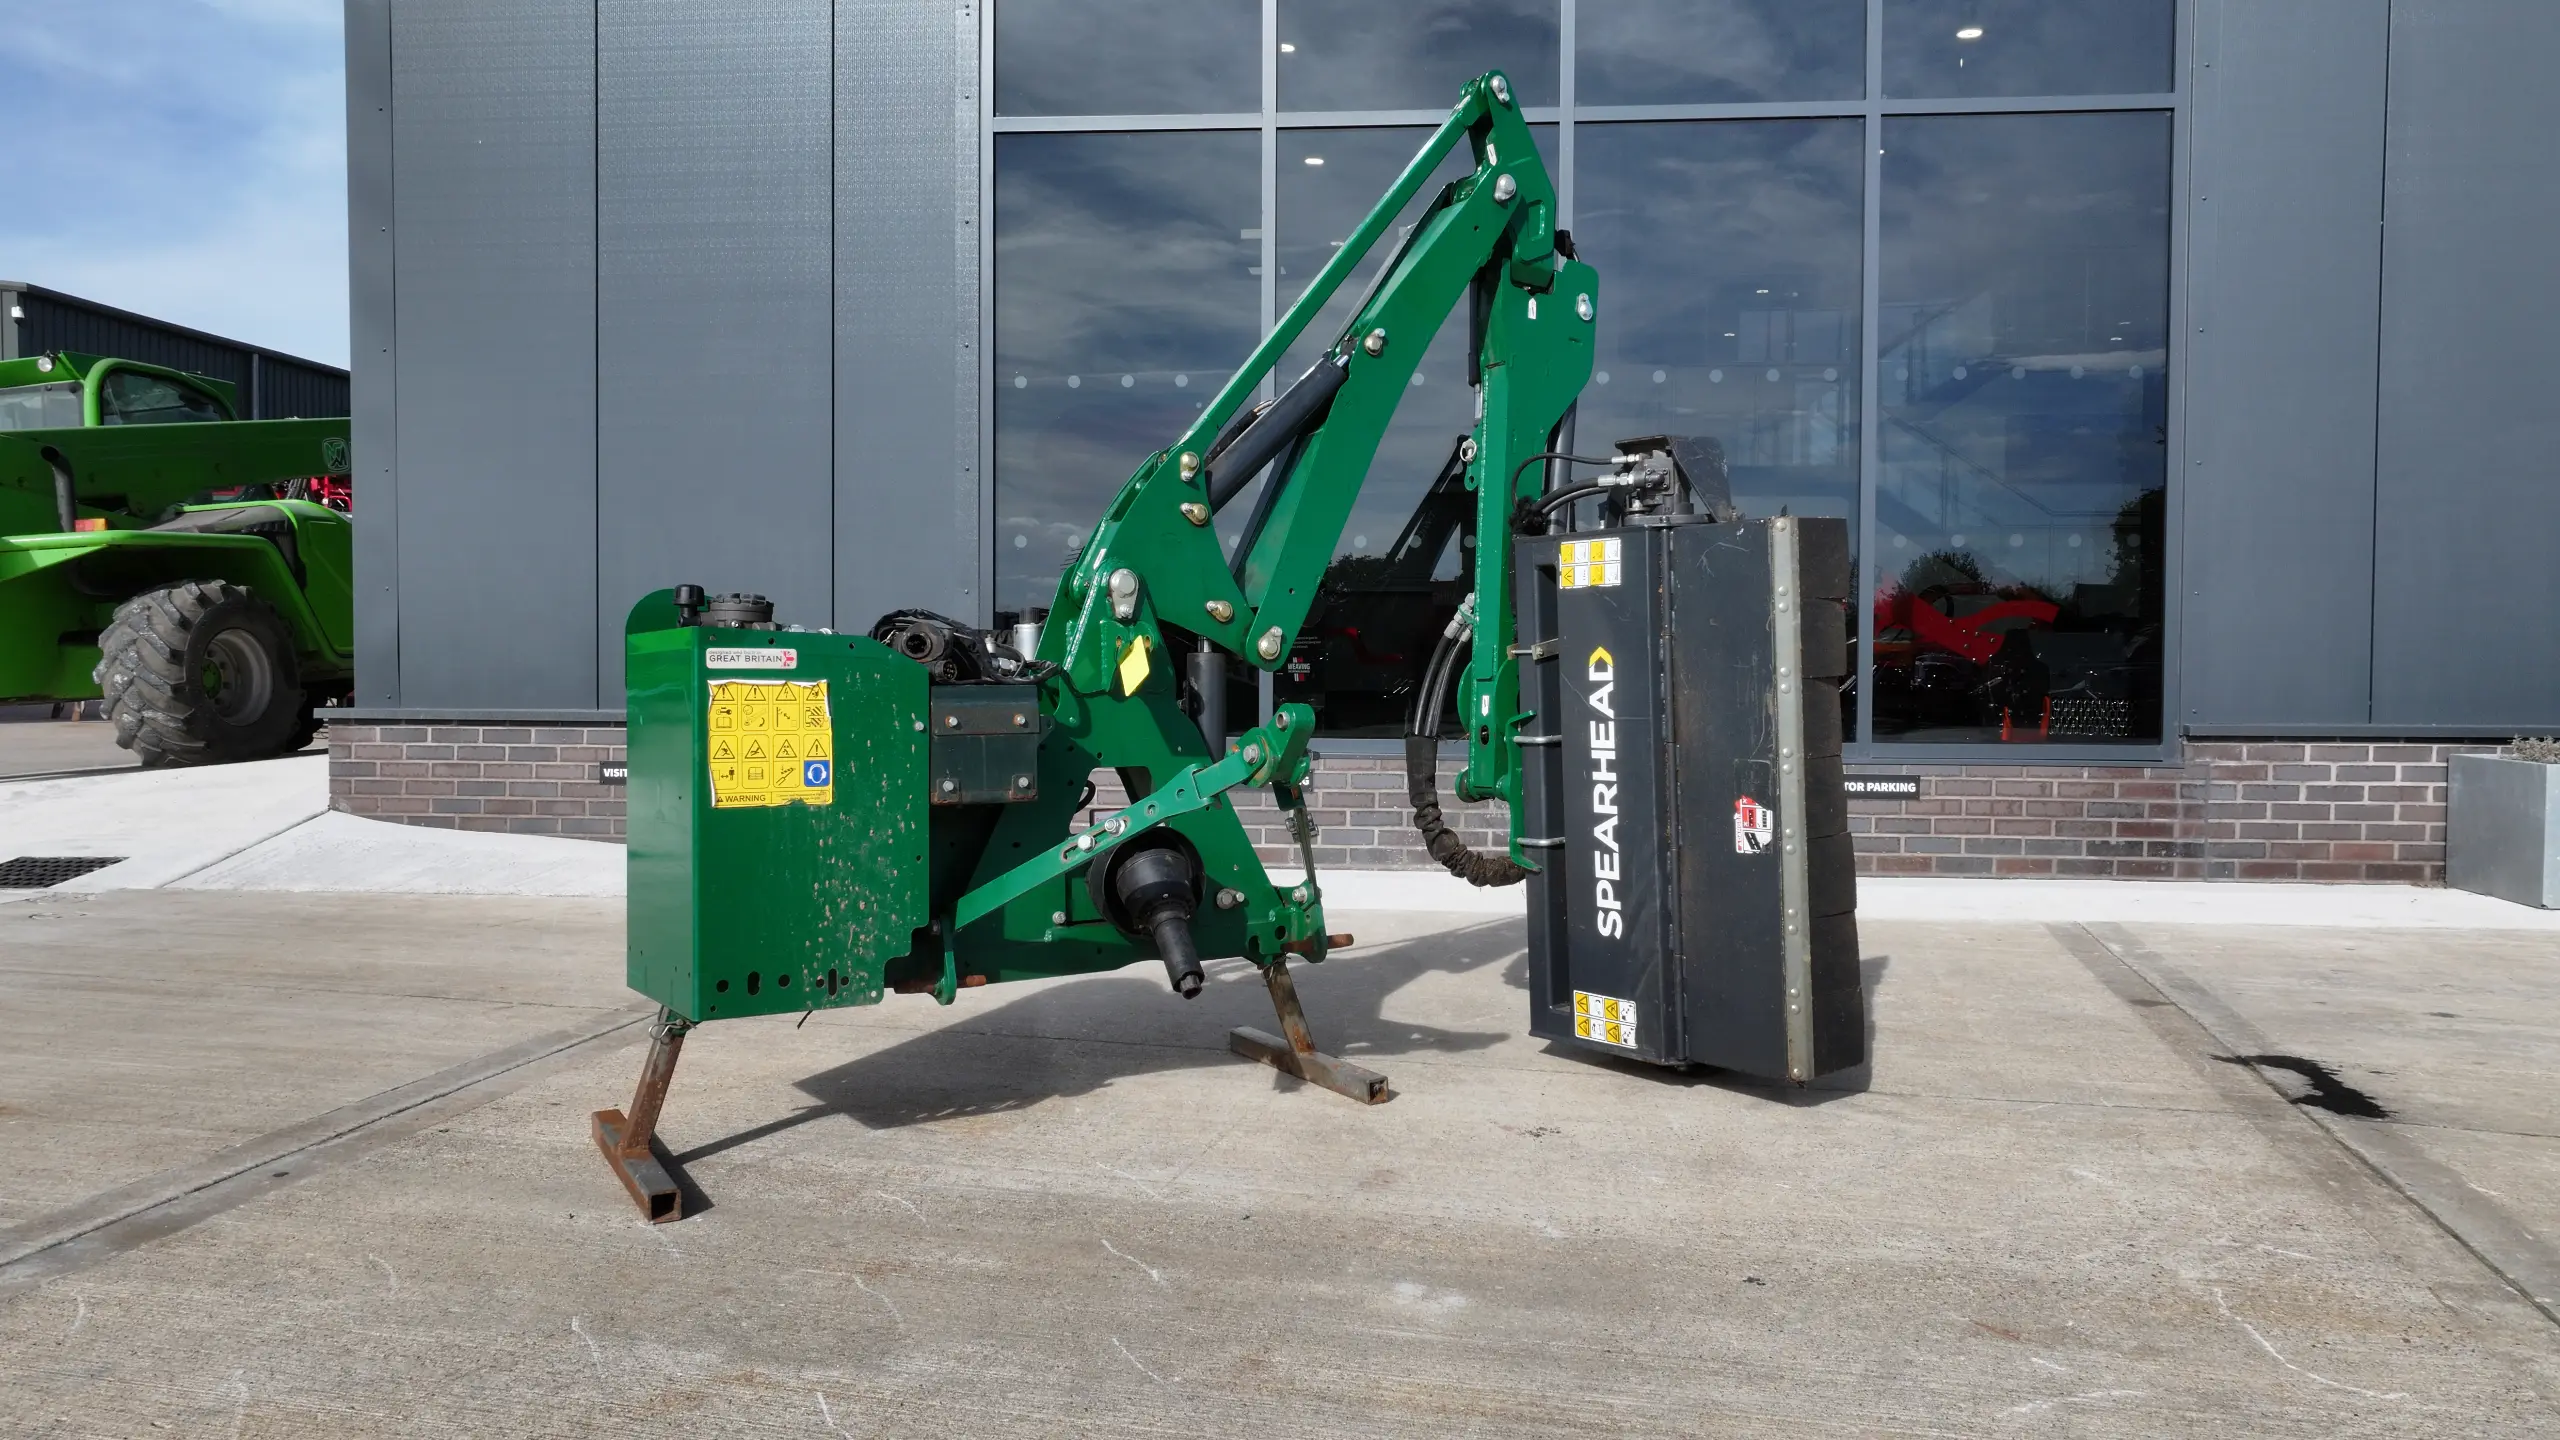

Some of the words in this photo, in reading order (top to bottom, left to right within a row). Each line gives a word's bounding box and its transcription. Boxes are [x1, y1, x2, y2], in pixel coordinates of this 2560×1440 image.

[709, 655, 741, 663] GREAT
[744, 655, 782, 663] BRITAIN
[603, 768, 627, 778] VISIT
[1866, 782, 1917, 793] PARKING
[1589, 646, 1622, 940] SPEARHEAD
[725, 794, 766, 803] WARNING
